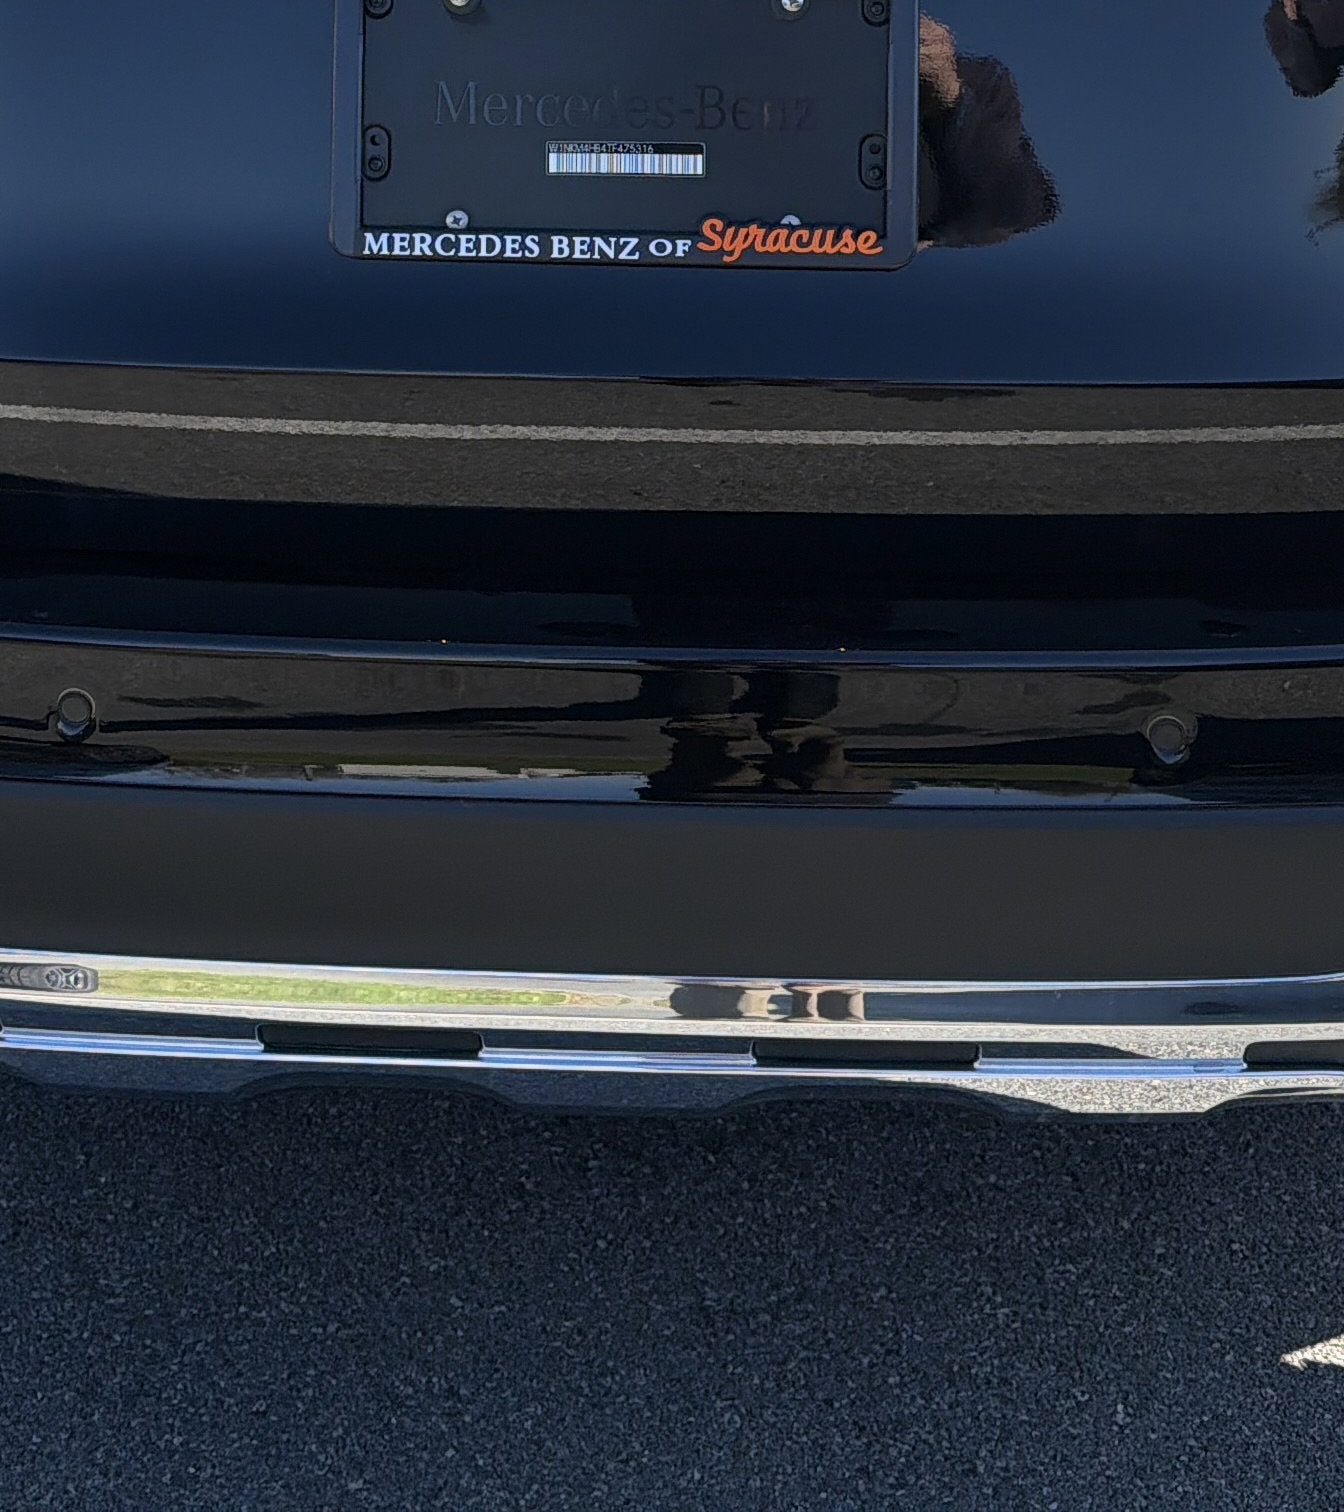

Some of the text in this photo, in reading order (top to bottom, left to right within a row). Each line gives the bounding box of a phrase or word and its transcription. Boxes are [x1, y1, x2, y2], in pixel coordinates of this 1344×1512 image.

[433, 79, 816, 132] Mercedes-Benz
[361, 217, 884, 263] MERCEDES BENZ OF Syracuse
